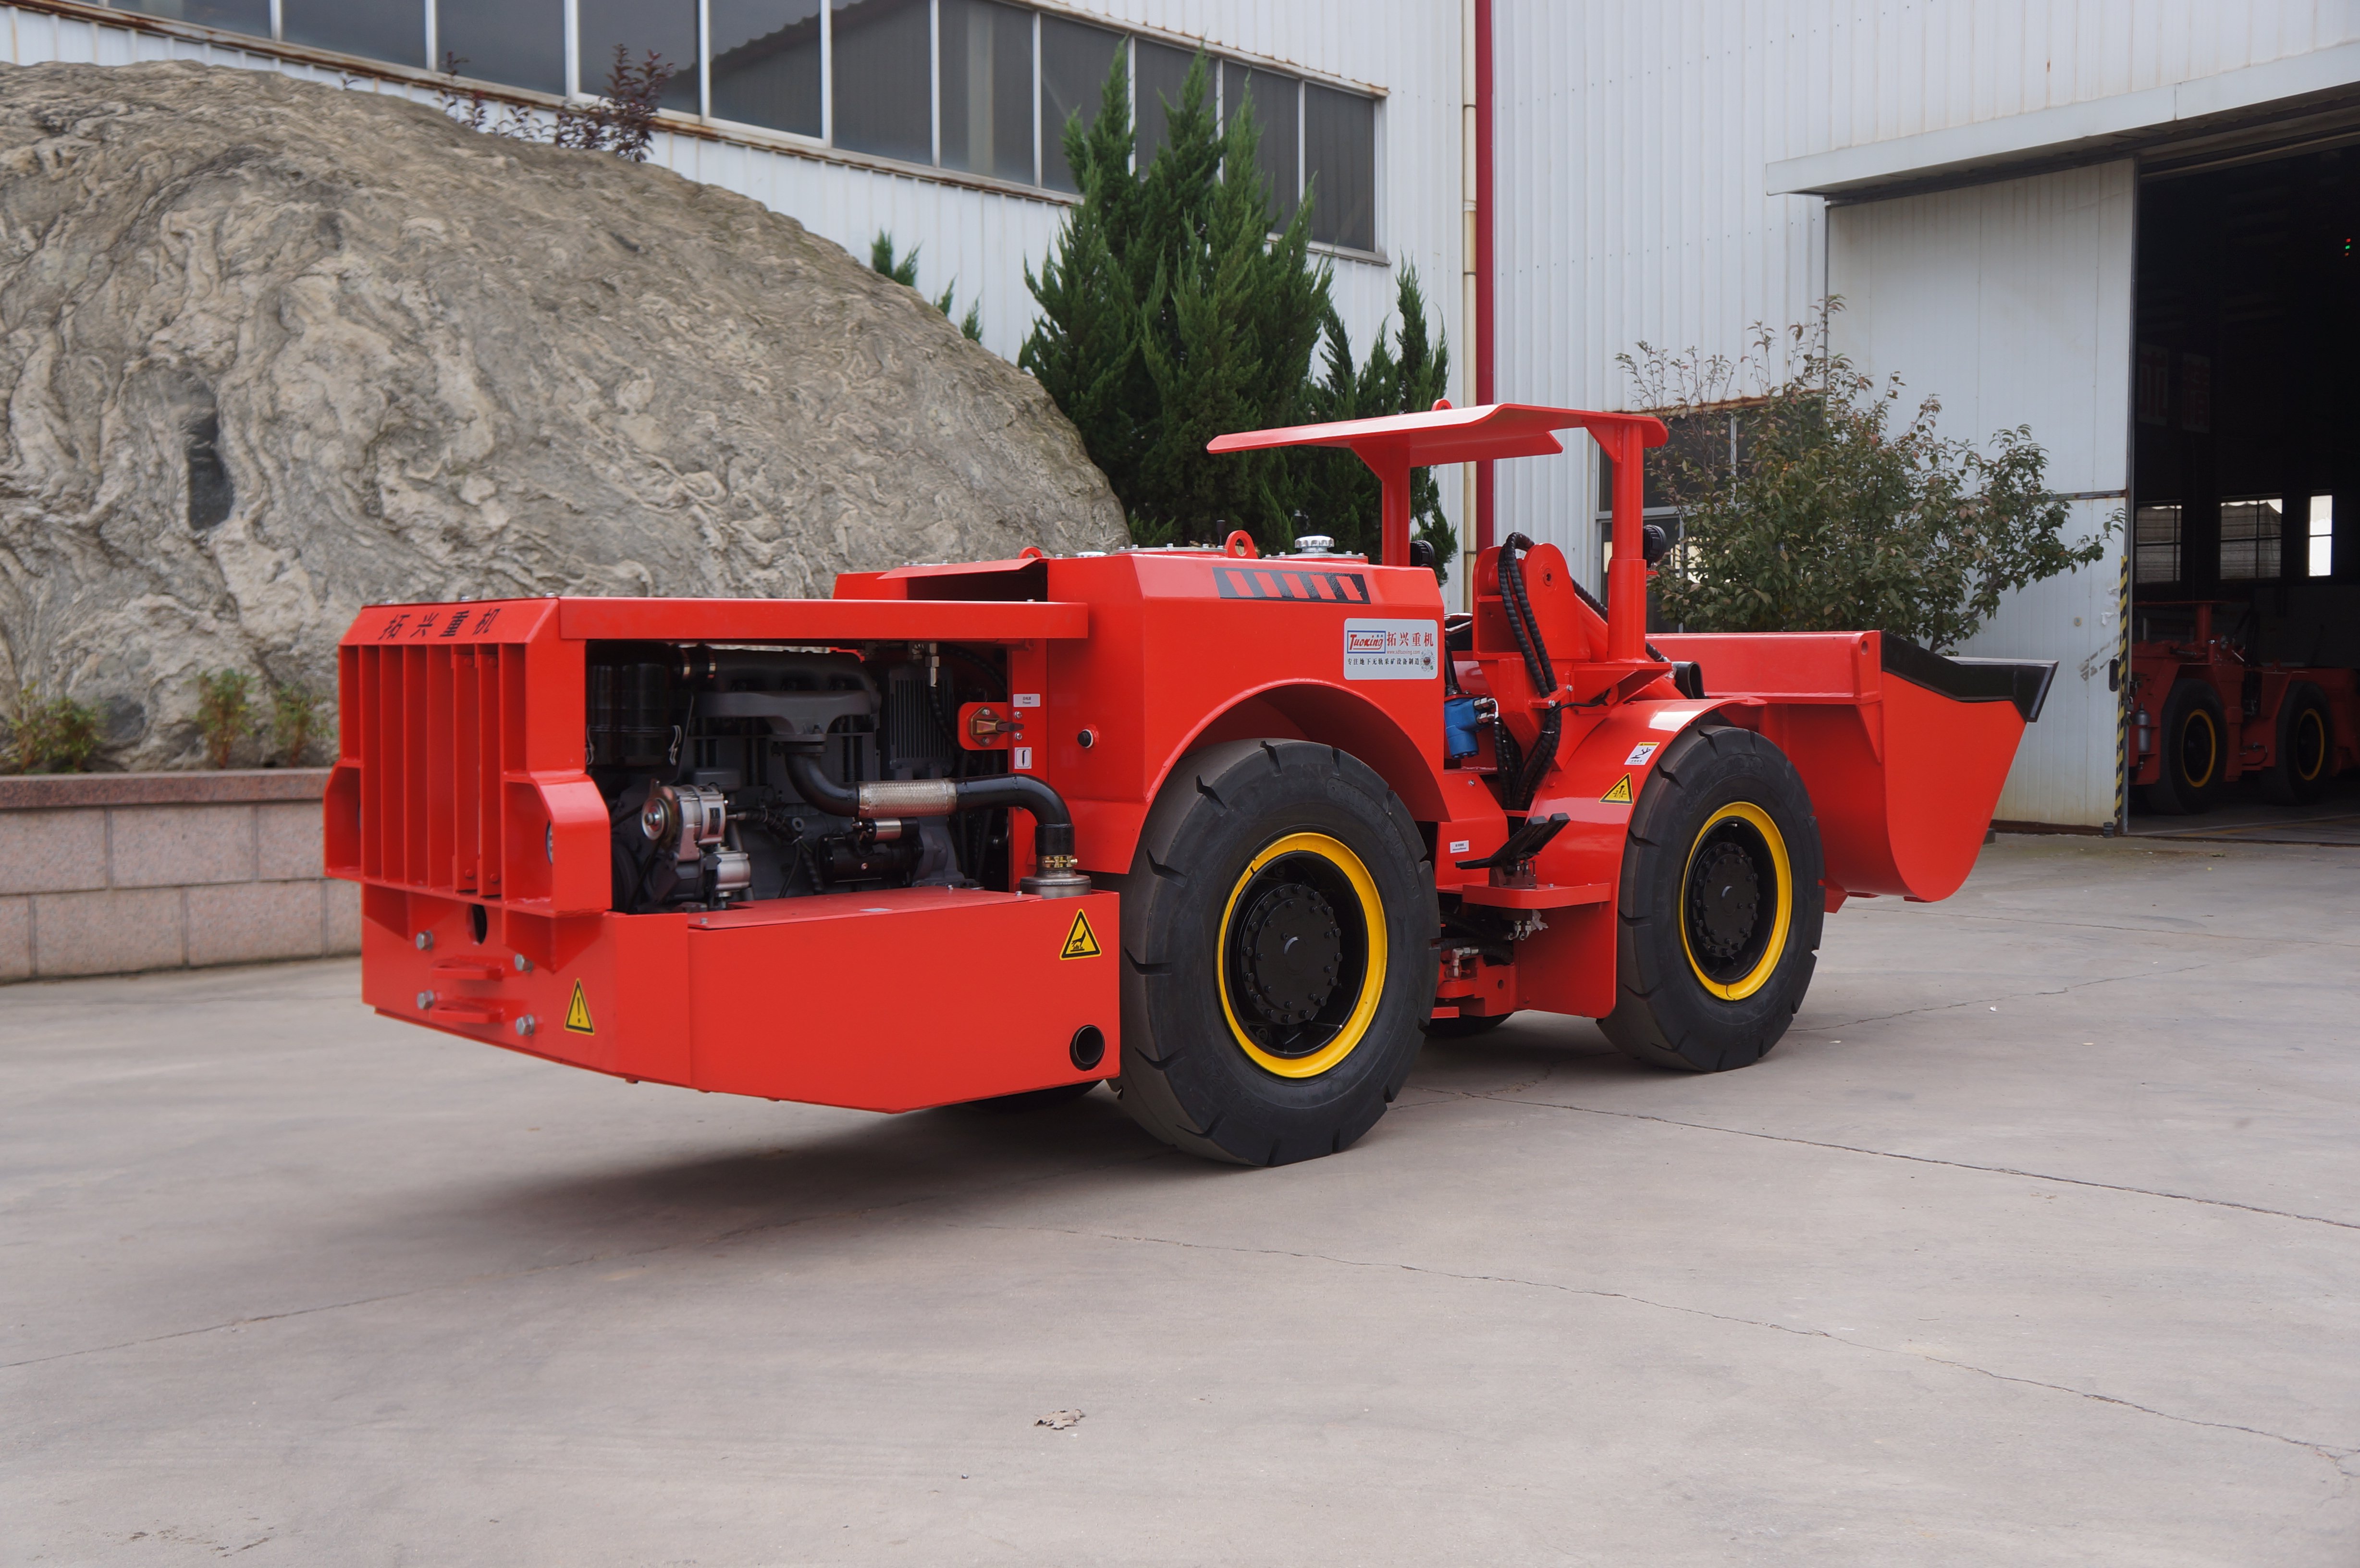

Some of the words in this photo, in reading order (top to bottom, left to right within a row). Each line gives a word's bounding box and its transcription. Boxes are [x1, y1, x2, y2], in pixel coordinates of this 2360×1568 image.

[378, 608, 501, 640] 拓兴重机
[1349, 634, 1383, 650] Tuoxing
[1387, 631, 1434, 647] 拓兴重机
[1347, 657, 1420, 665] 专注地下无轨采矿设备制造
